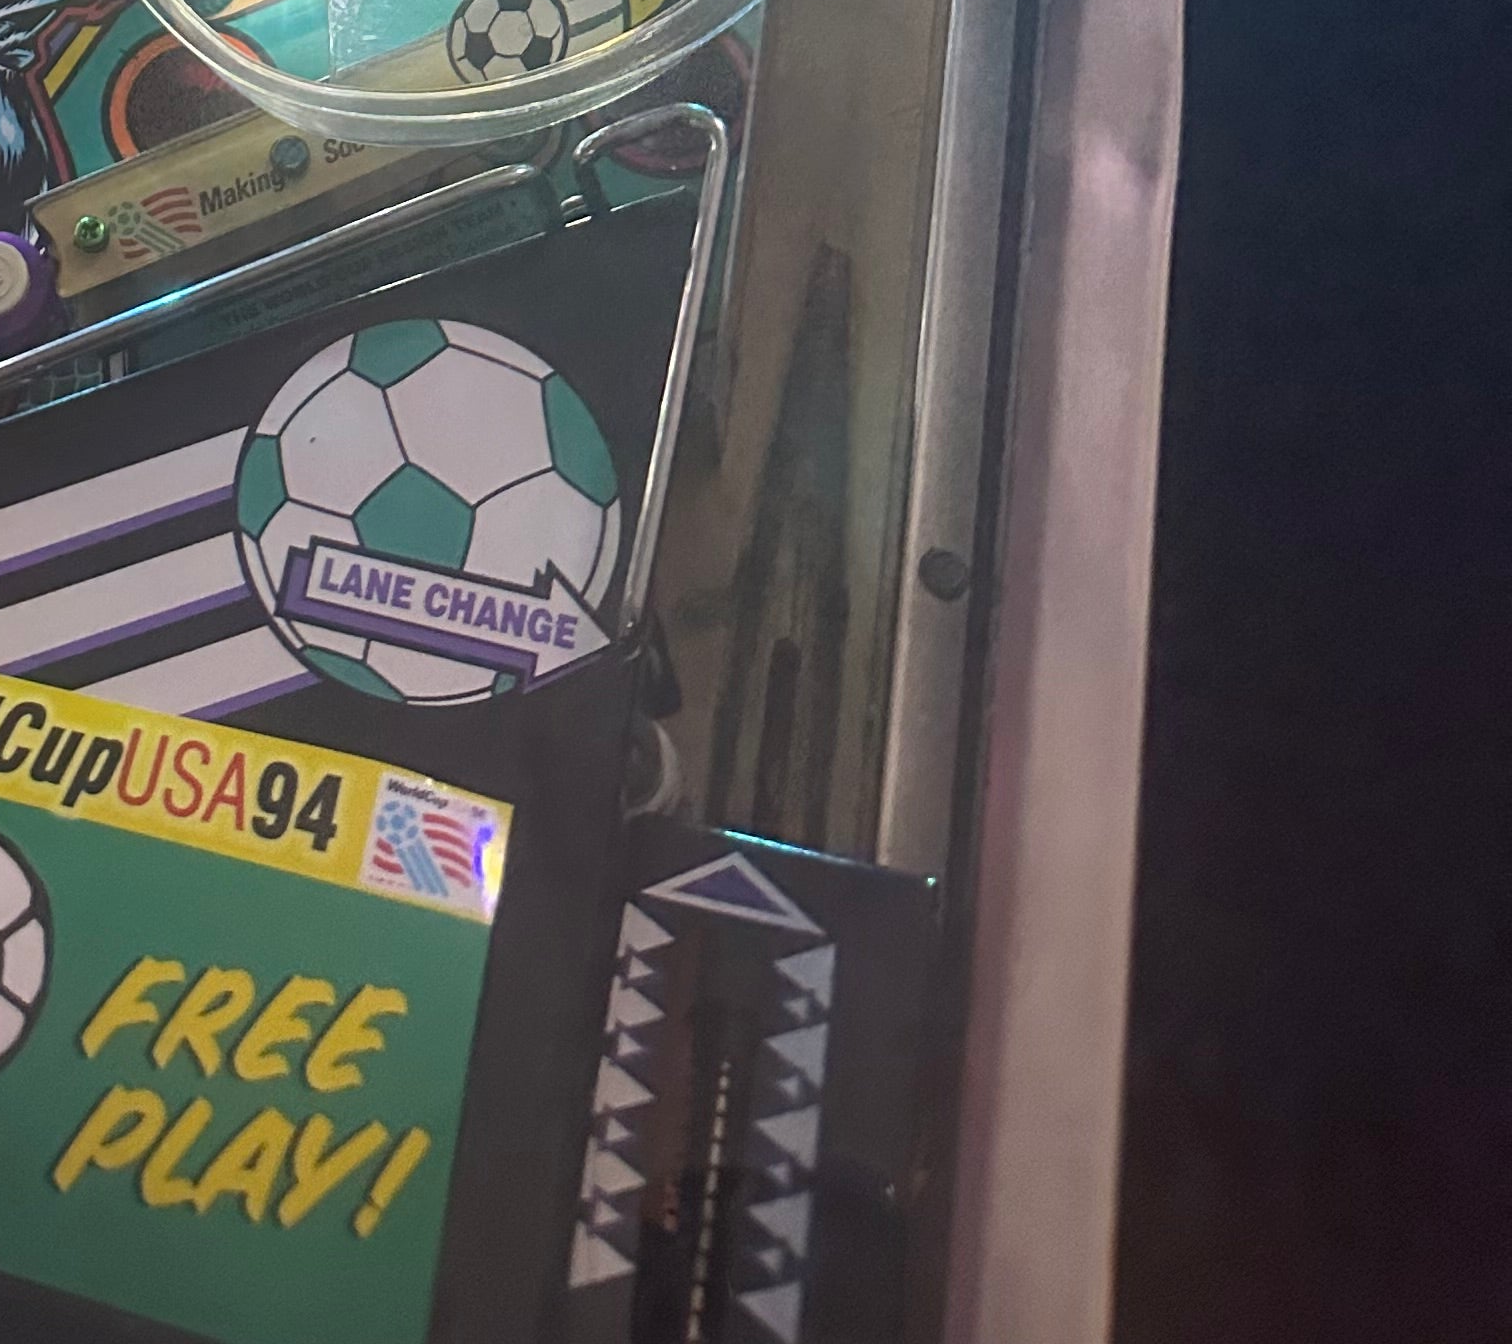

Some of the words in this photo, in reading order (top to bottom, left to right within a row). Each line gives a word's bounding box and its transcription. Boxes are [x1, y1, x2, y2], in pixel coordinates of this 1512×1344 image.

[199, 164, 285, 217] Making
[319, 557, 416, 611] LANE
[424, 587, 578, 650] CHANGE
[80, 950, 409, 1094] FREE
[52, 1083, 431, 1239] PLAY!
